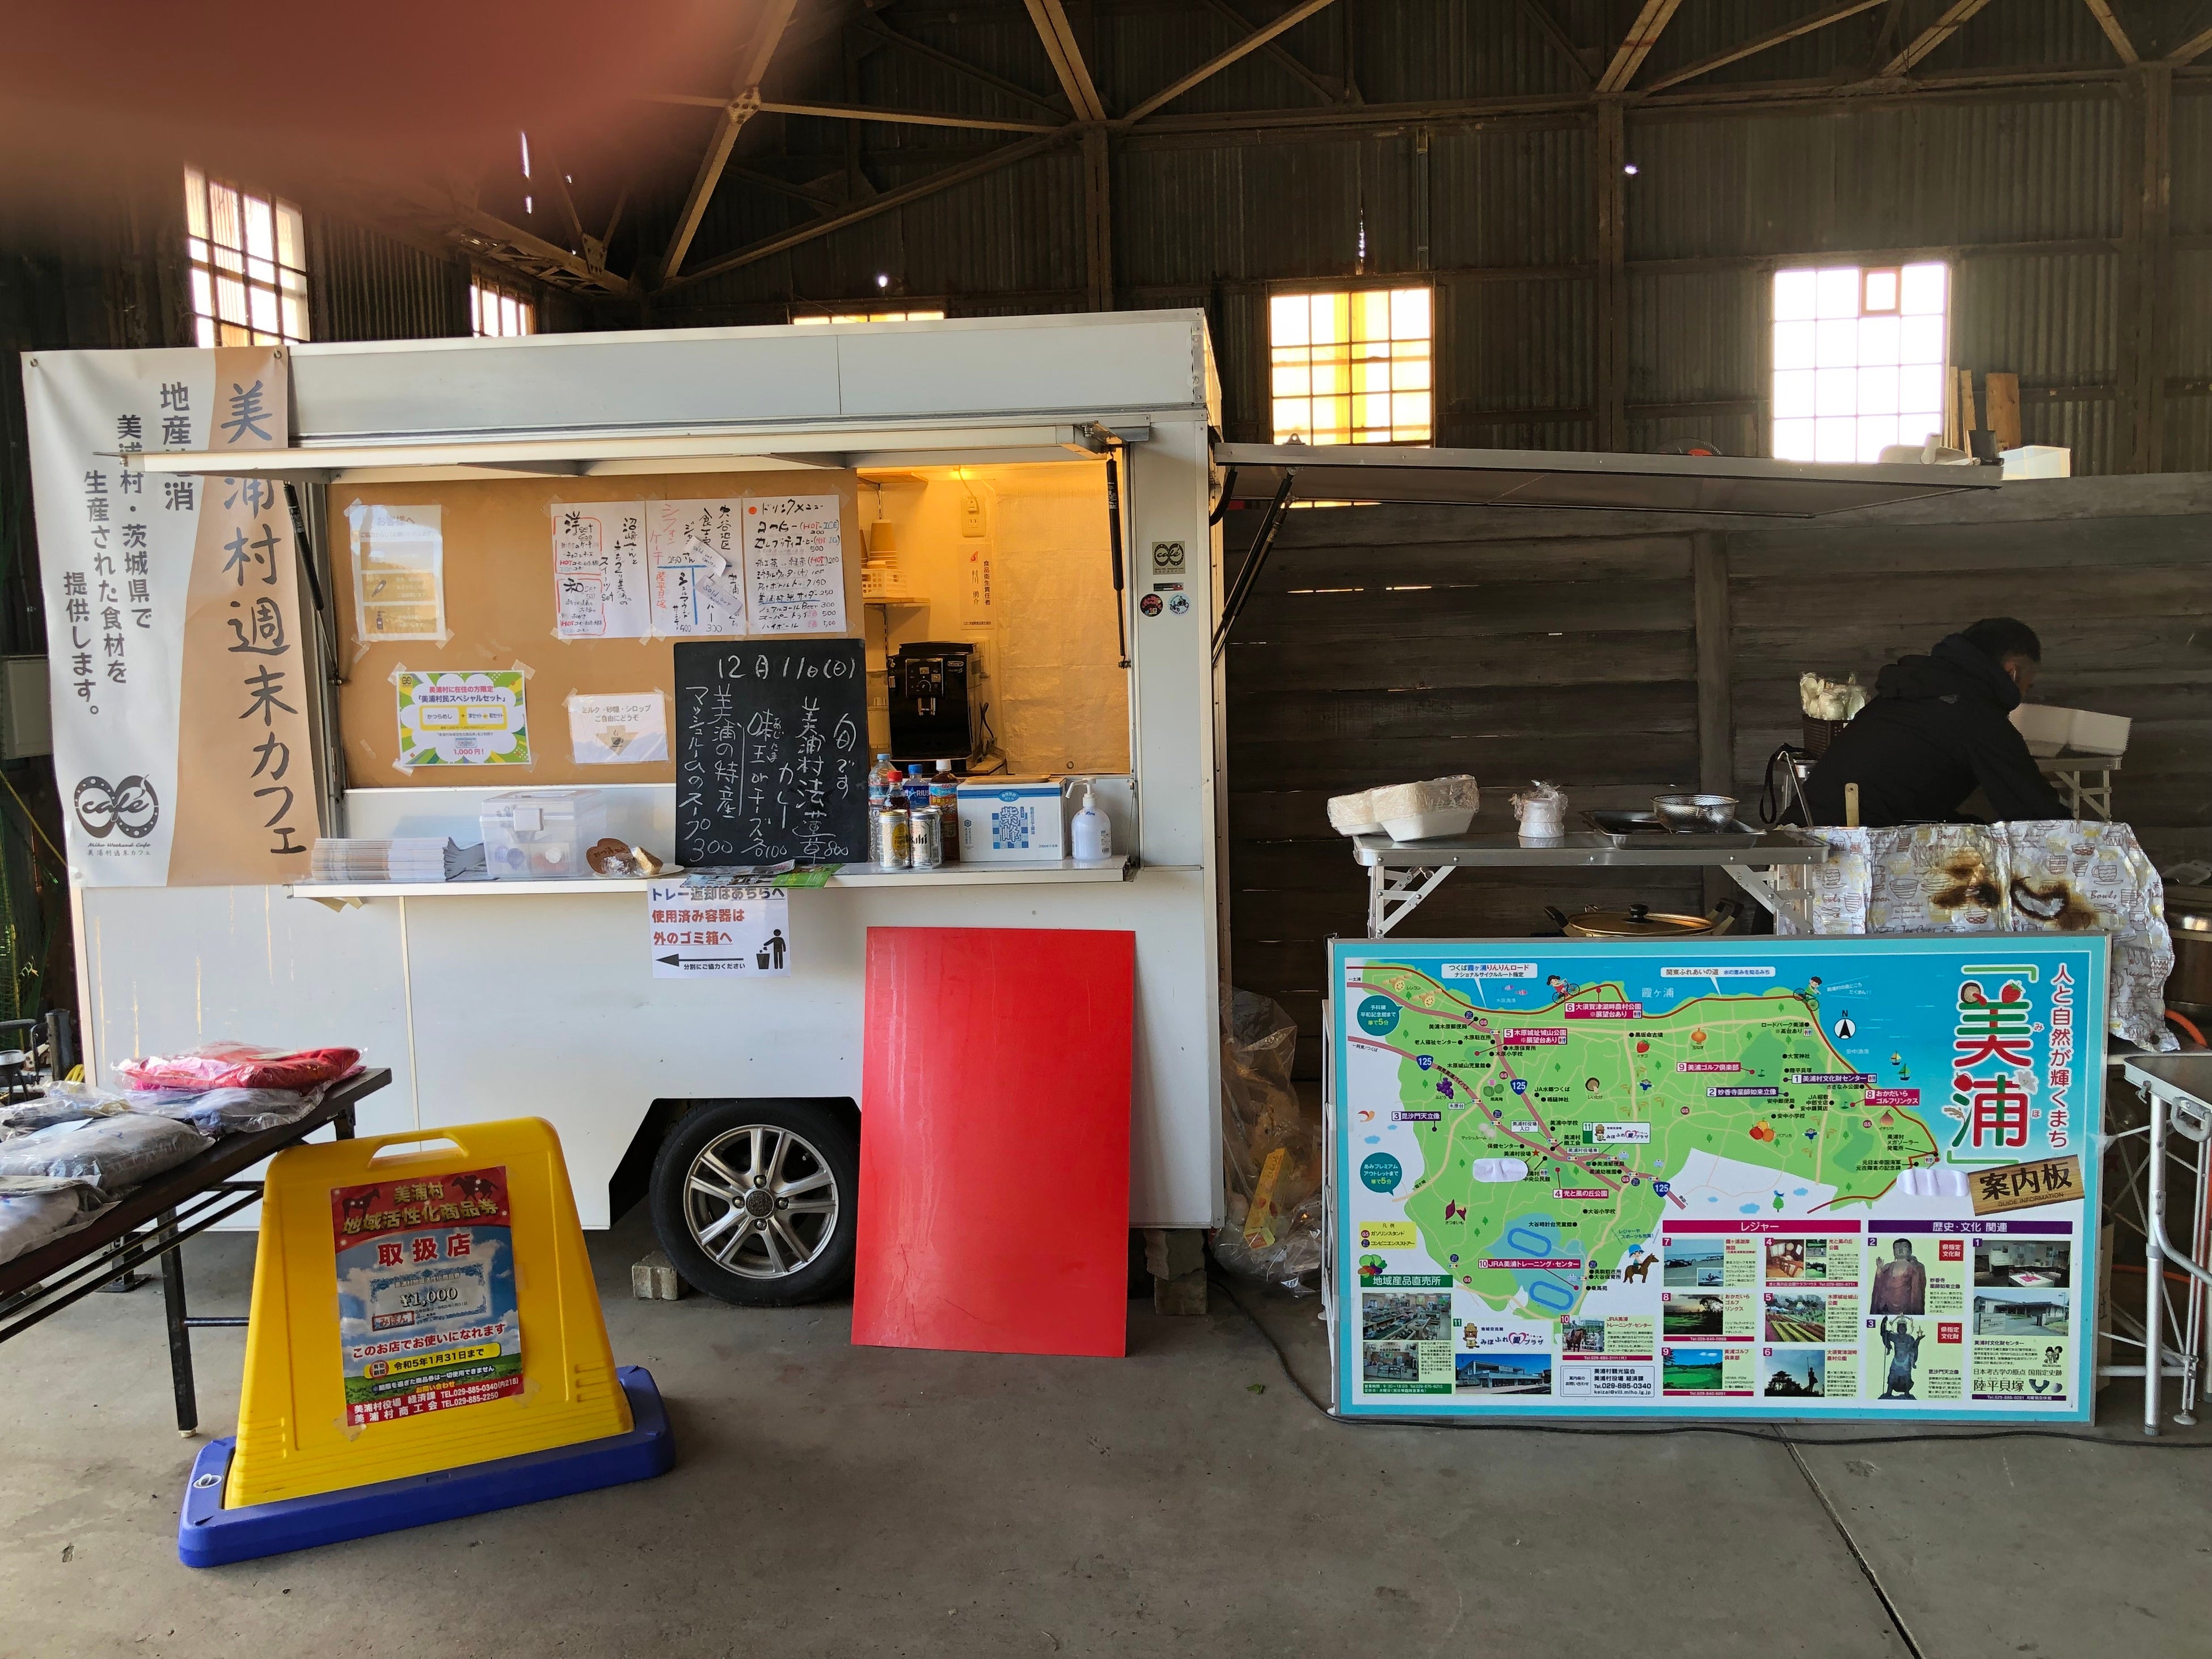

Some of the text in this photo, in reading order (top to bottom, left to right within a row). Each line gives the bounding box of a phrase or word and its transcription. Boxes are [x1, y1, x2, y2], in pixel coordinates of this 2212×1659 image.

[160, 382, 194, 510] 地産消
[762, 499, 824, 516] ドリンクメニュー
[667, 556, 682, 564] 250
[84, 470, 127, 683] 生産された食材を
[221, 379, 307, 855] 美浦村週末カフェ
[706, 624, 723, 633] 300
[63, 571, 99, 716] 提供します。
[429, 685, 493, 694] 美浦村に在住の方限定
[419, 694, 506, 703] 「美浦村民スペシャルセット」
[581, 704, 652, 714] ミルク・砂糖・シロップ
[594, 714, 640, 723] ご自由にどうぞ
[707, 683, 738, 819] 美浦の特産
[833, 713, 857, 799] 旬です
[776, 762, 794, 829] カレー
[82, 790, 149, 822] café
[1001, 806, 1021, 843] 紫峰
[690, 838, 734, 862] 300
[824, 840, 849, 858] 800
[652, 887, 786, 901] トレー返却はあちらへ
[2090, 890, 2118, 900] Bowls
[652, 909, 745, 923] 使用済み容器は
[653, 931, 733, 945] 外のゴミ箱へ
[1641, 987, 1675, 999] 霞ヶ浦
[1417, 1057, 1433, 1066] 125
[2048, 964, 2074, 1149] 人と自然が輝くまち
[1511, 1082, 1527, 1091] 125
[1654, 1183, 1669, 1193] 125
[1979, 1162, 2073, 1201] 案内板
[394, 1181, 445, 1204] 美浦村
[1998, 1192, 2064, 1207] GUIDE INFORMATION
[342, 1198, 499, 1235] 地域活性化商品券
[1741, 1221, 1780, 1232] レジャー
[1932, 1222, 2008, 1232] 歴史・文化 関連
[377, 1232, 471, 1267] 取扱店
[1479, 1259, 1580, 1269] 10 JRA美浦トレーニング・センター
[1373, 1276, 1441, 1286] 地域産品直売所
[399, 1287, 459, 1308] ¥1,000
[379, 1315, 408, 1328] みほん
[353, 1323, 506, 1360] このお店でお使いになれます
[393, 1348, 484, 1371] 令和5年1月31日まで
[416, 1381, 456, 1394] お問い合わせ
[1973, 1379, 2025, 1393] 陸平貝塚
[353, 1397, 402, 1415] 美浦村役場
[407, 1390, 437, 1405] 経済課
